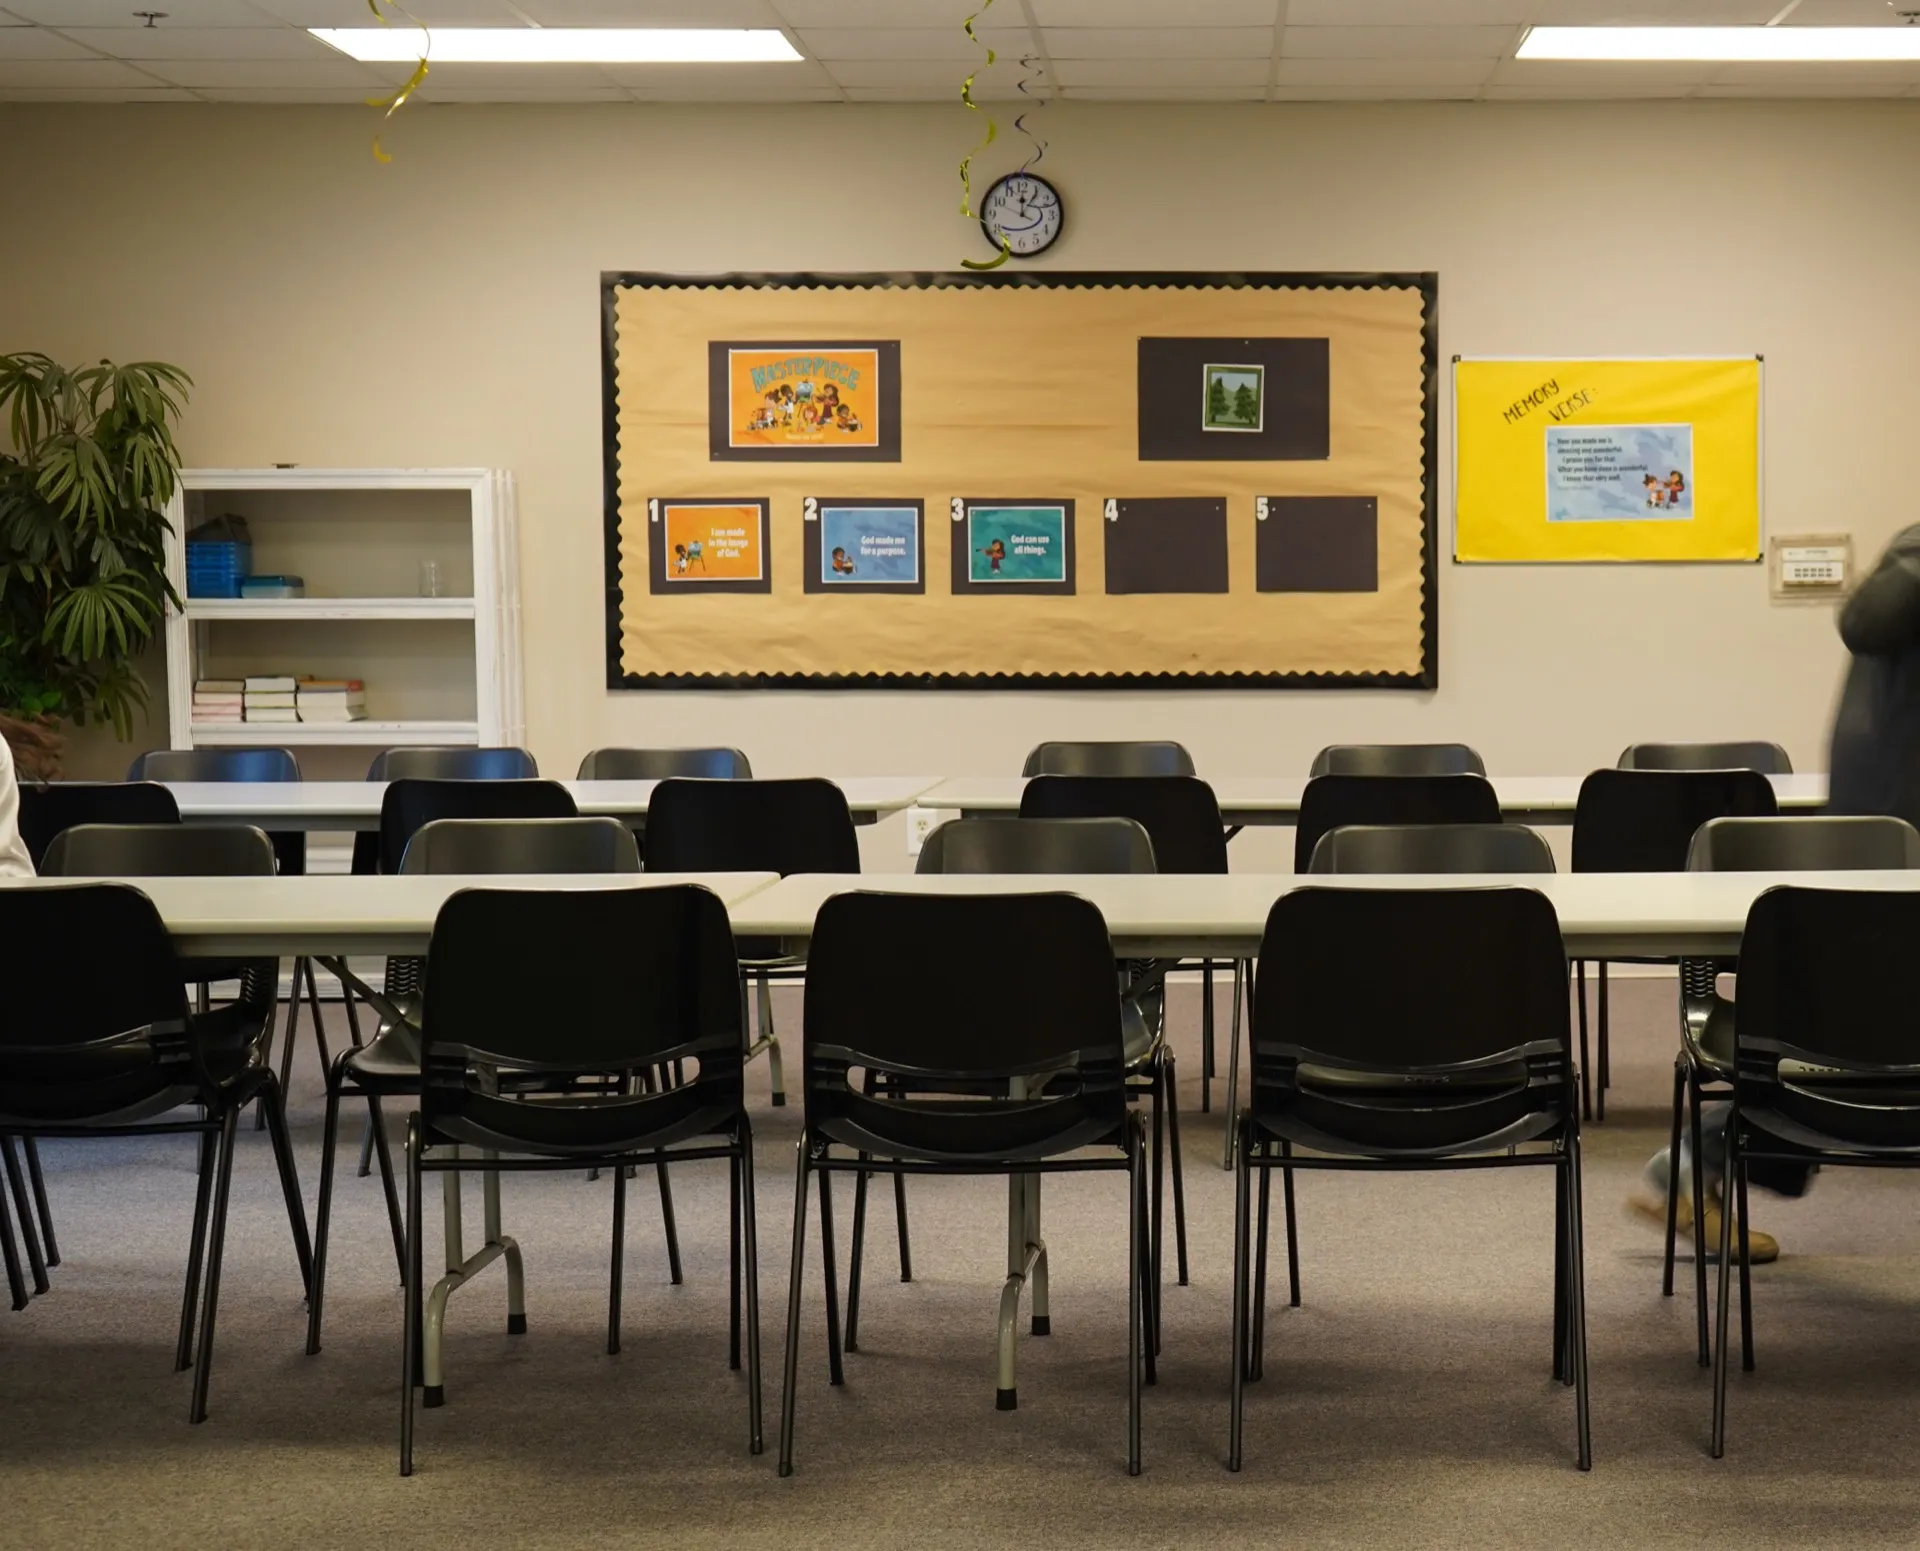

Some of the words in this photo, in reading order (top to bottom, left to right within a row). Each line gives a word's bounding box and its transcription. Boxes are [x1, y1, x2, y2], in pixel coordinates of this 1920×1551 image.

[1018, 182, 1028, 193] 12
[994, 196, 1005, 207] 10
[1043, 194, 1049, 206] 2
[989, 209, 996, 220] 9
[1048, 210, 1055, 221] 3
[994, 223, 1000, 234] 8
[1043, 224, 1048, 235] 4
[1018, 237, 1025, 248] 6
[1032, 233, 1039, 245] 5
[750, 356, 860, 394] MASTERPIECE
[1502, 378, 1560, 424] MEMORY
[649, 498, 658, 522] 1
[804, 497, 817, 521] 2
[951, 497, 964, 521] 3
[1105, 498, 1118, 522] 4
[1256, 497, 1269, 520] 5
[711, 528, 714, 536] I
[726, 528, 745, 536] made
[716, 539, 727, 547] the
[728, 538, 748, 548] image
[861, 536, 874, 545] God
[876, 536, 893, 545] made
[1011, 535, 1024, 544] God
[1025, 536, 1037, 544] can
[1038, 536, 1050, 544] use
[717, 548, 724, 557] of
[861, 547, 871, 556] for
[877, 548, 906, 557] purpose.
[1014, 546, 1023, 554] all
[1024, 546, 1046, 556] things.
